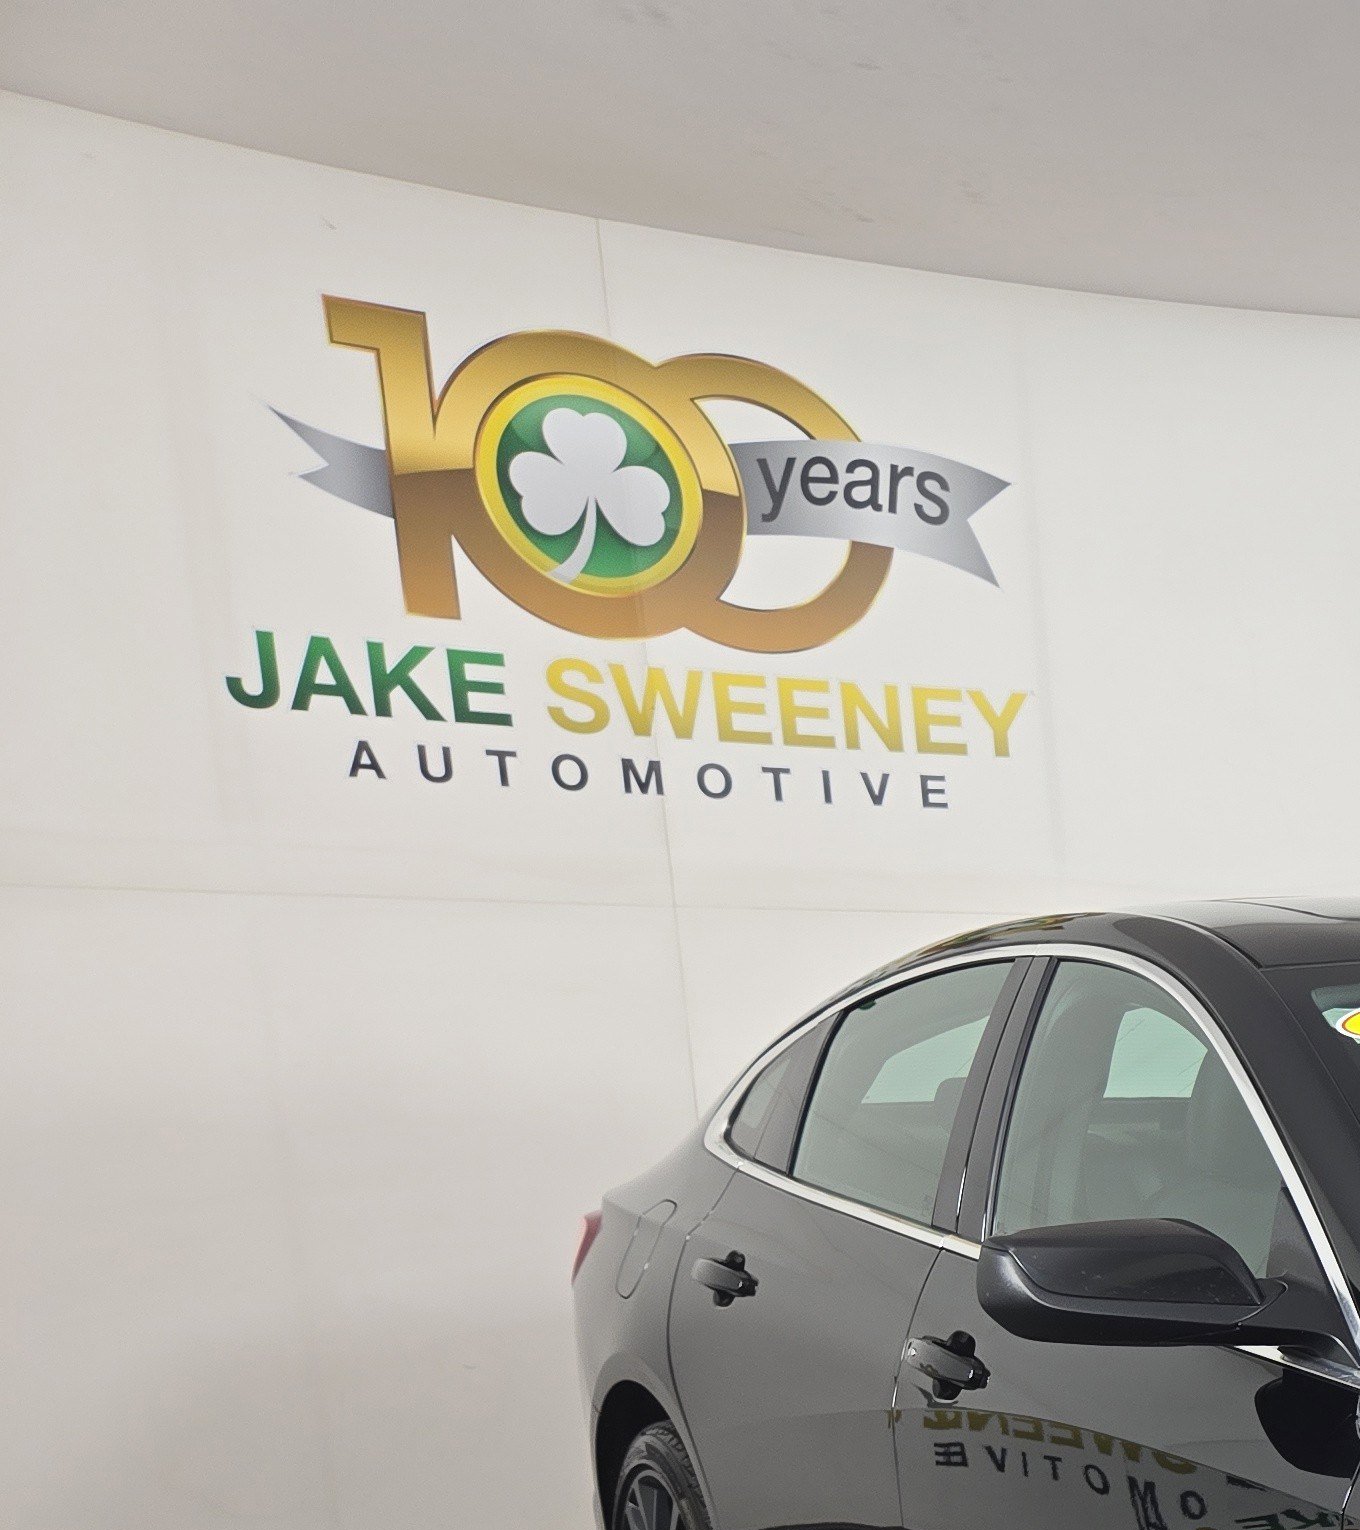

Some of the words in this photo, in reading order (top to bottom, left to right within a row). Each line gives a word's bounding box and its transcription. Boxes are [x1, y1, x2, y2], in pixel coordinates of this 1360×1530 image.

[321, 293, 896, 655] 100
[755, 450, 951, 527] years
[225, 629, 514, 728] JAKE
[544, 656, 1028, 758] SWEENEY
[348, 739, 949, 809] AUTOMOTIVE
